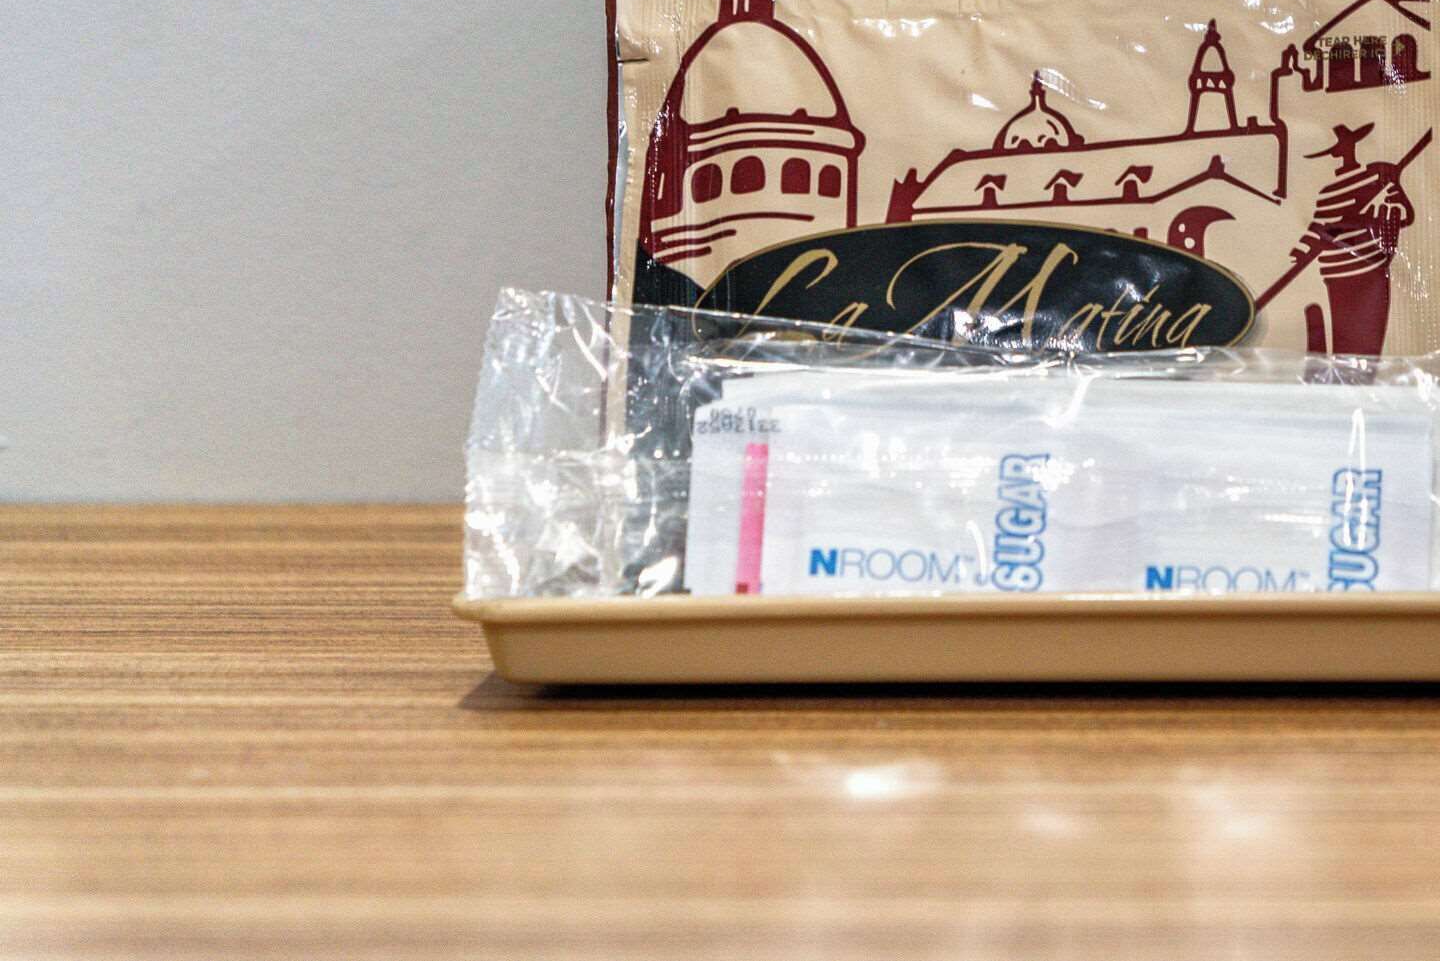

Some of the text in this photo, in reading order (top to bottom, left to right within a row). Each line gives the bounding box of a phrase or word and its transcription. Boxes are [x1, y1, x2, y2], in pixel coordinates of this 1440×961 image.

[1319, 34, 1388, 48] TEAR HERE
[719, 242, 1212, 353] La Matina
[991, 452, 1050, 592] SUGAR
